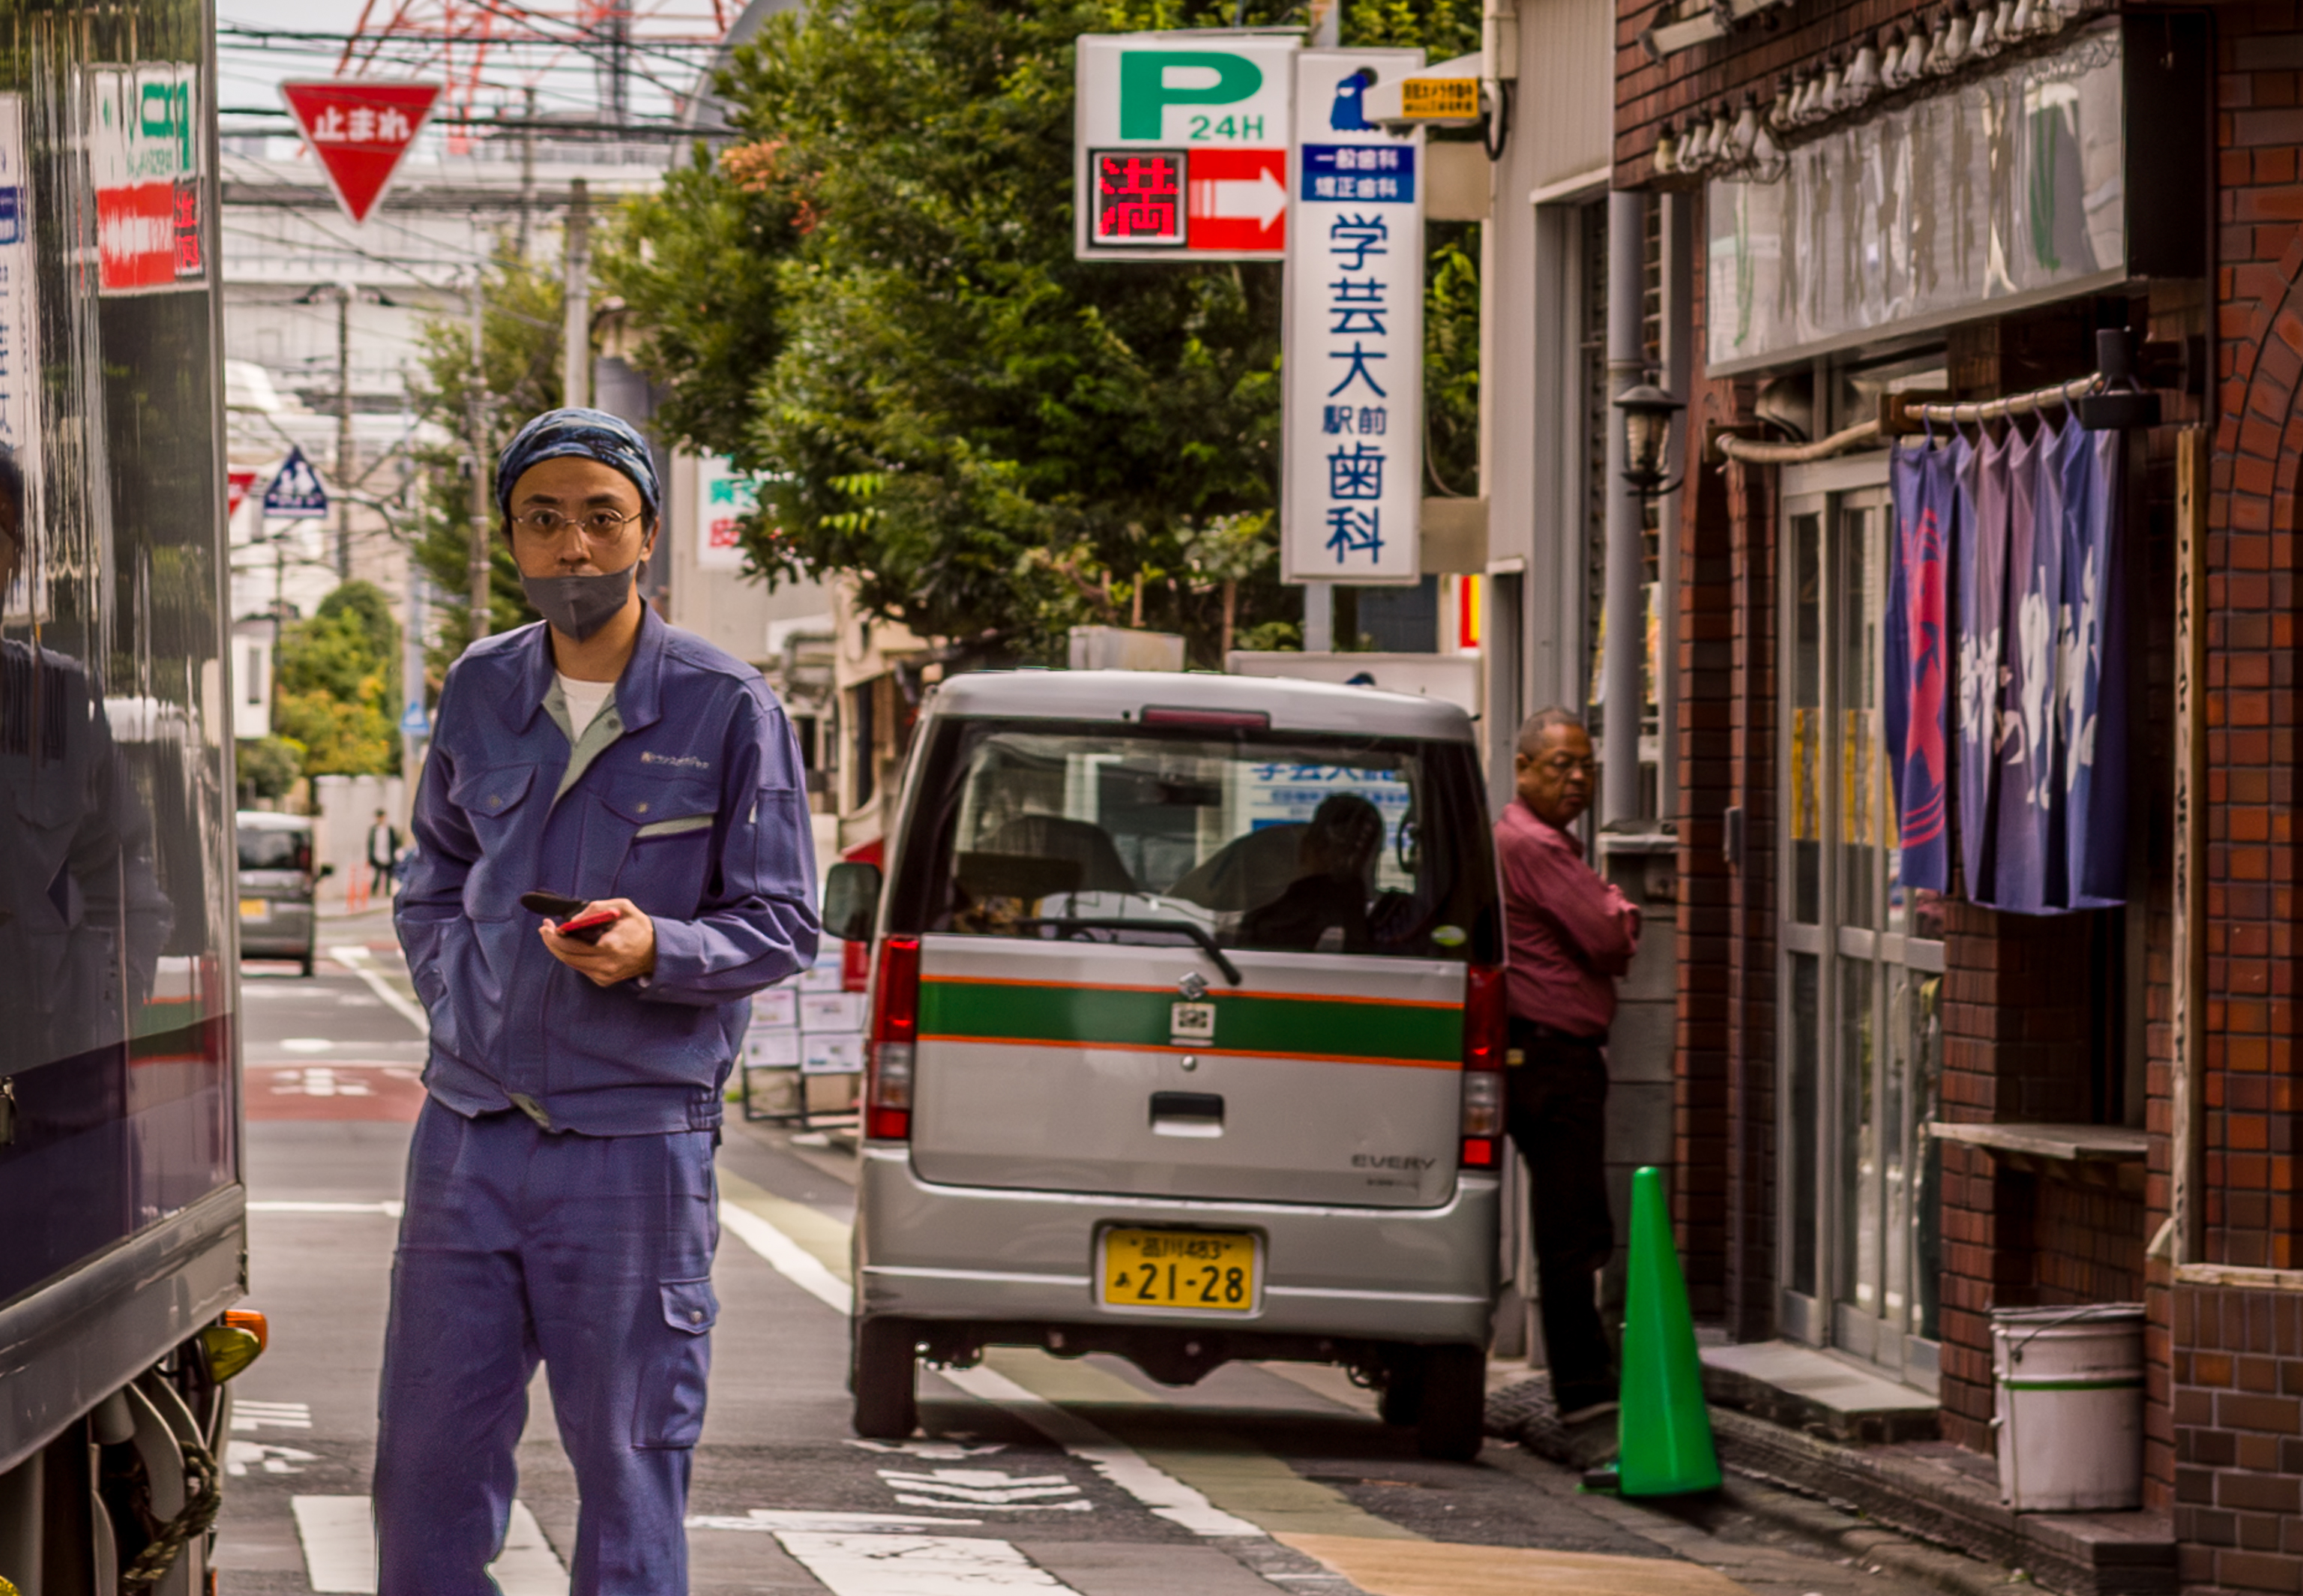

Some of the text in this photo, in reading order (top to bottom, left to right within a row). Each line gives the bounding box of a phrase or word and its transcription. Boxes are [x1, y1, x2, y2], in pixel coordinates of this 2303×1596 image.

[1121, 51, 1262, 139] P
[312, 105, 411, 142] 止まれ
[1189, 115, 1263, 140] 24H
[1315, 148, 1399, 171] 一般歯科
[1098, 157, 1178, 238] 満
[1351, 1154, 1437, 1170] EVERY
[1137, 1262, 1244, 1304] 21-28
